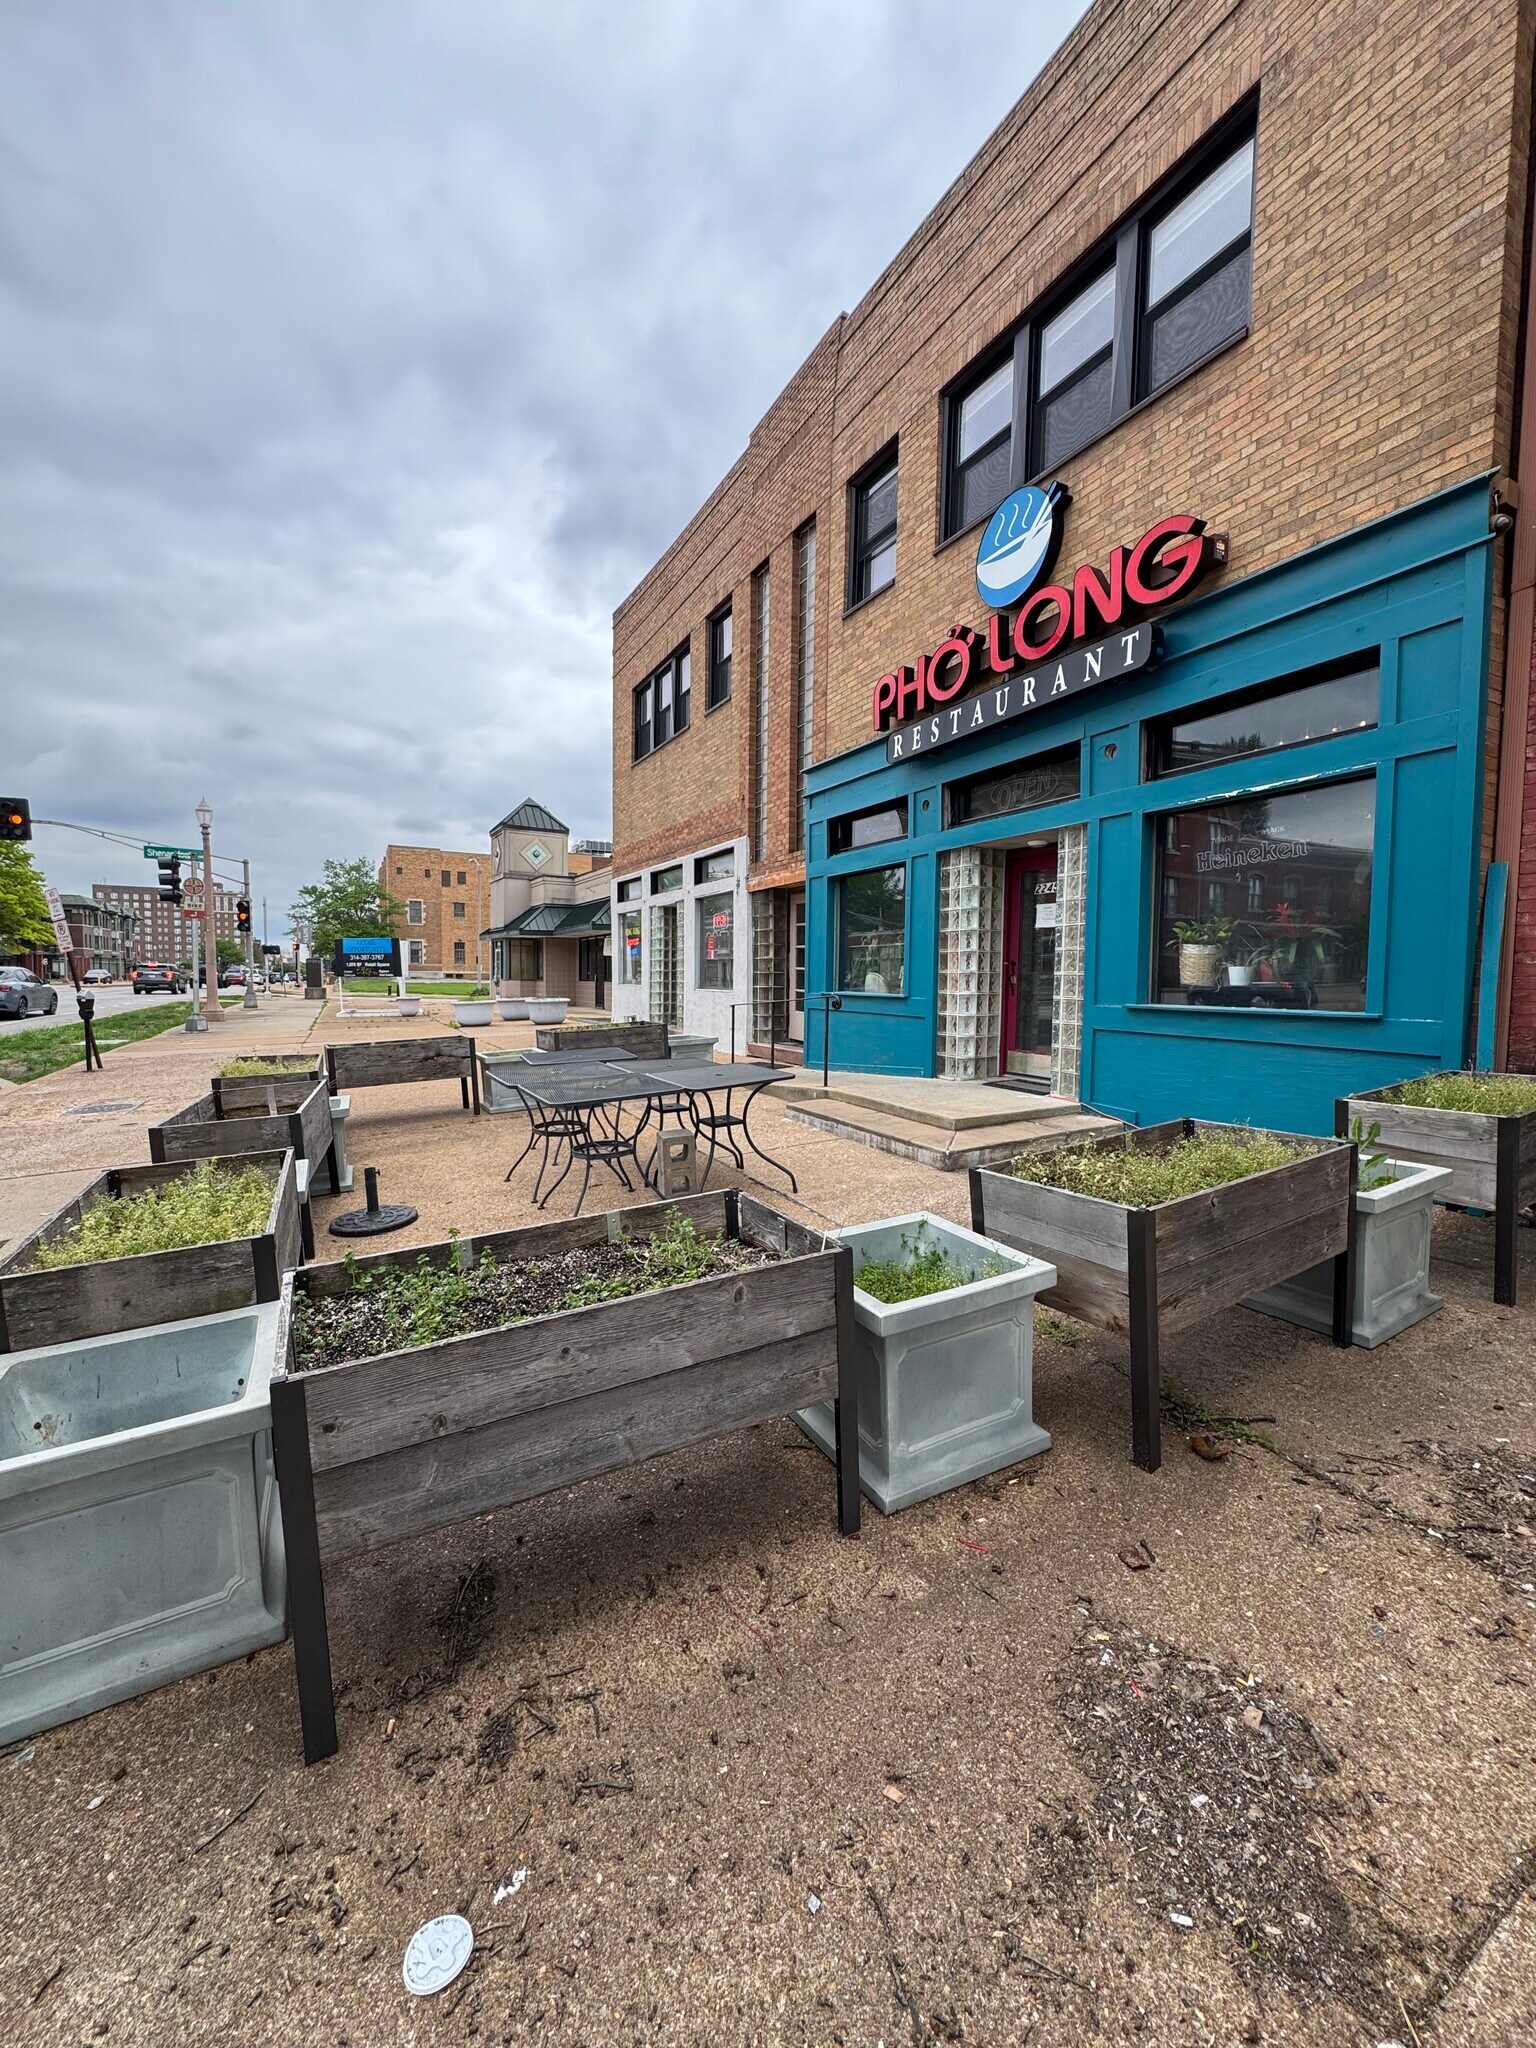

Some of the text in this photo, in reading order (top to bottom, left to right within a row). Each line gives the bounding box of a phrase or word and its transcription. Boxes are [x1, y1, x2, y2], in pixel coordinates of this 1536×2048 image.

[989, 514, 1205, 673] LONG
[892, 631, 1140, 759] RESTAURANT
[996, 767, 1051, 811] OPEN
[1196, 840, 1308, 872] Heineken
